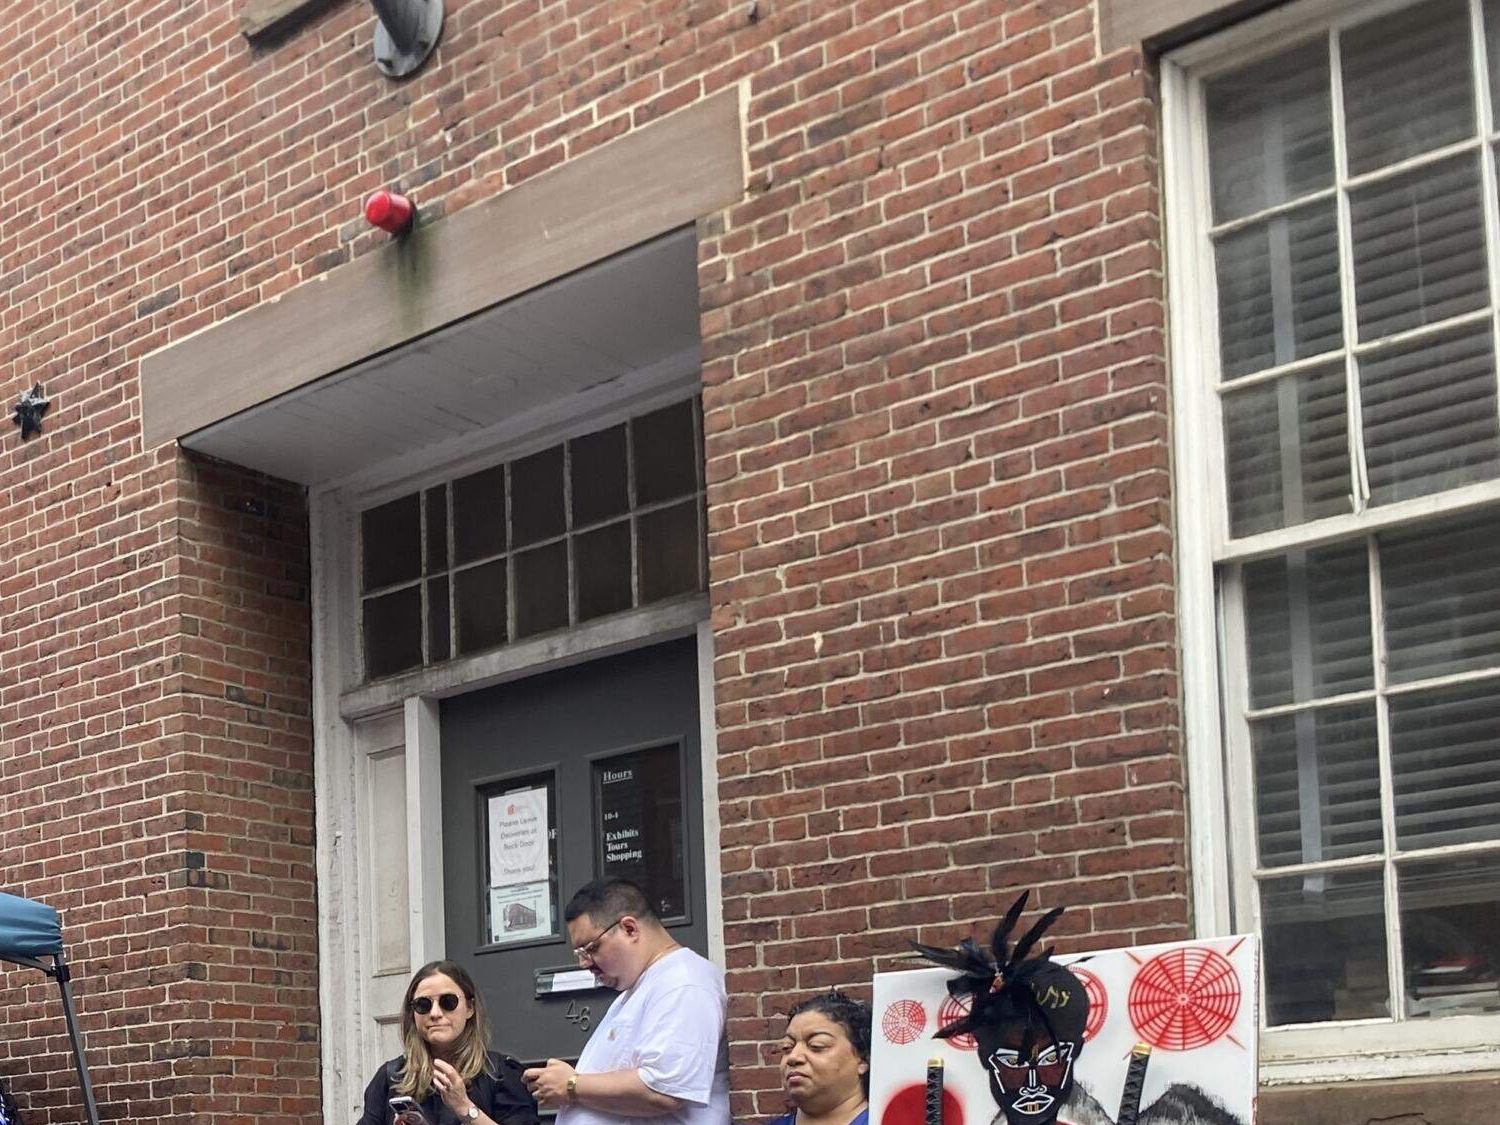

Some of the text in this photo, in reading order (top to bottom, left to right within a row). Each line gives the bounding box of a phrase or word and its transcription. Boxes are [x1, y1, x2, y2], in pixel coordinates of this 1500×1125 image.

[603, 770, 633, 783] Hours
[606, 828, 639, 841] Exhibits
[606, 842, 628, 852] Tours
[606, 849, 642, 863] Shopping
[565, 1000, 590, 1031] 46
